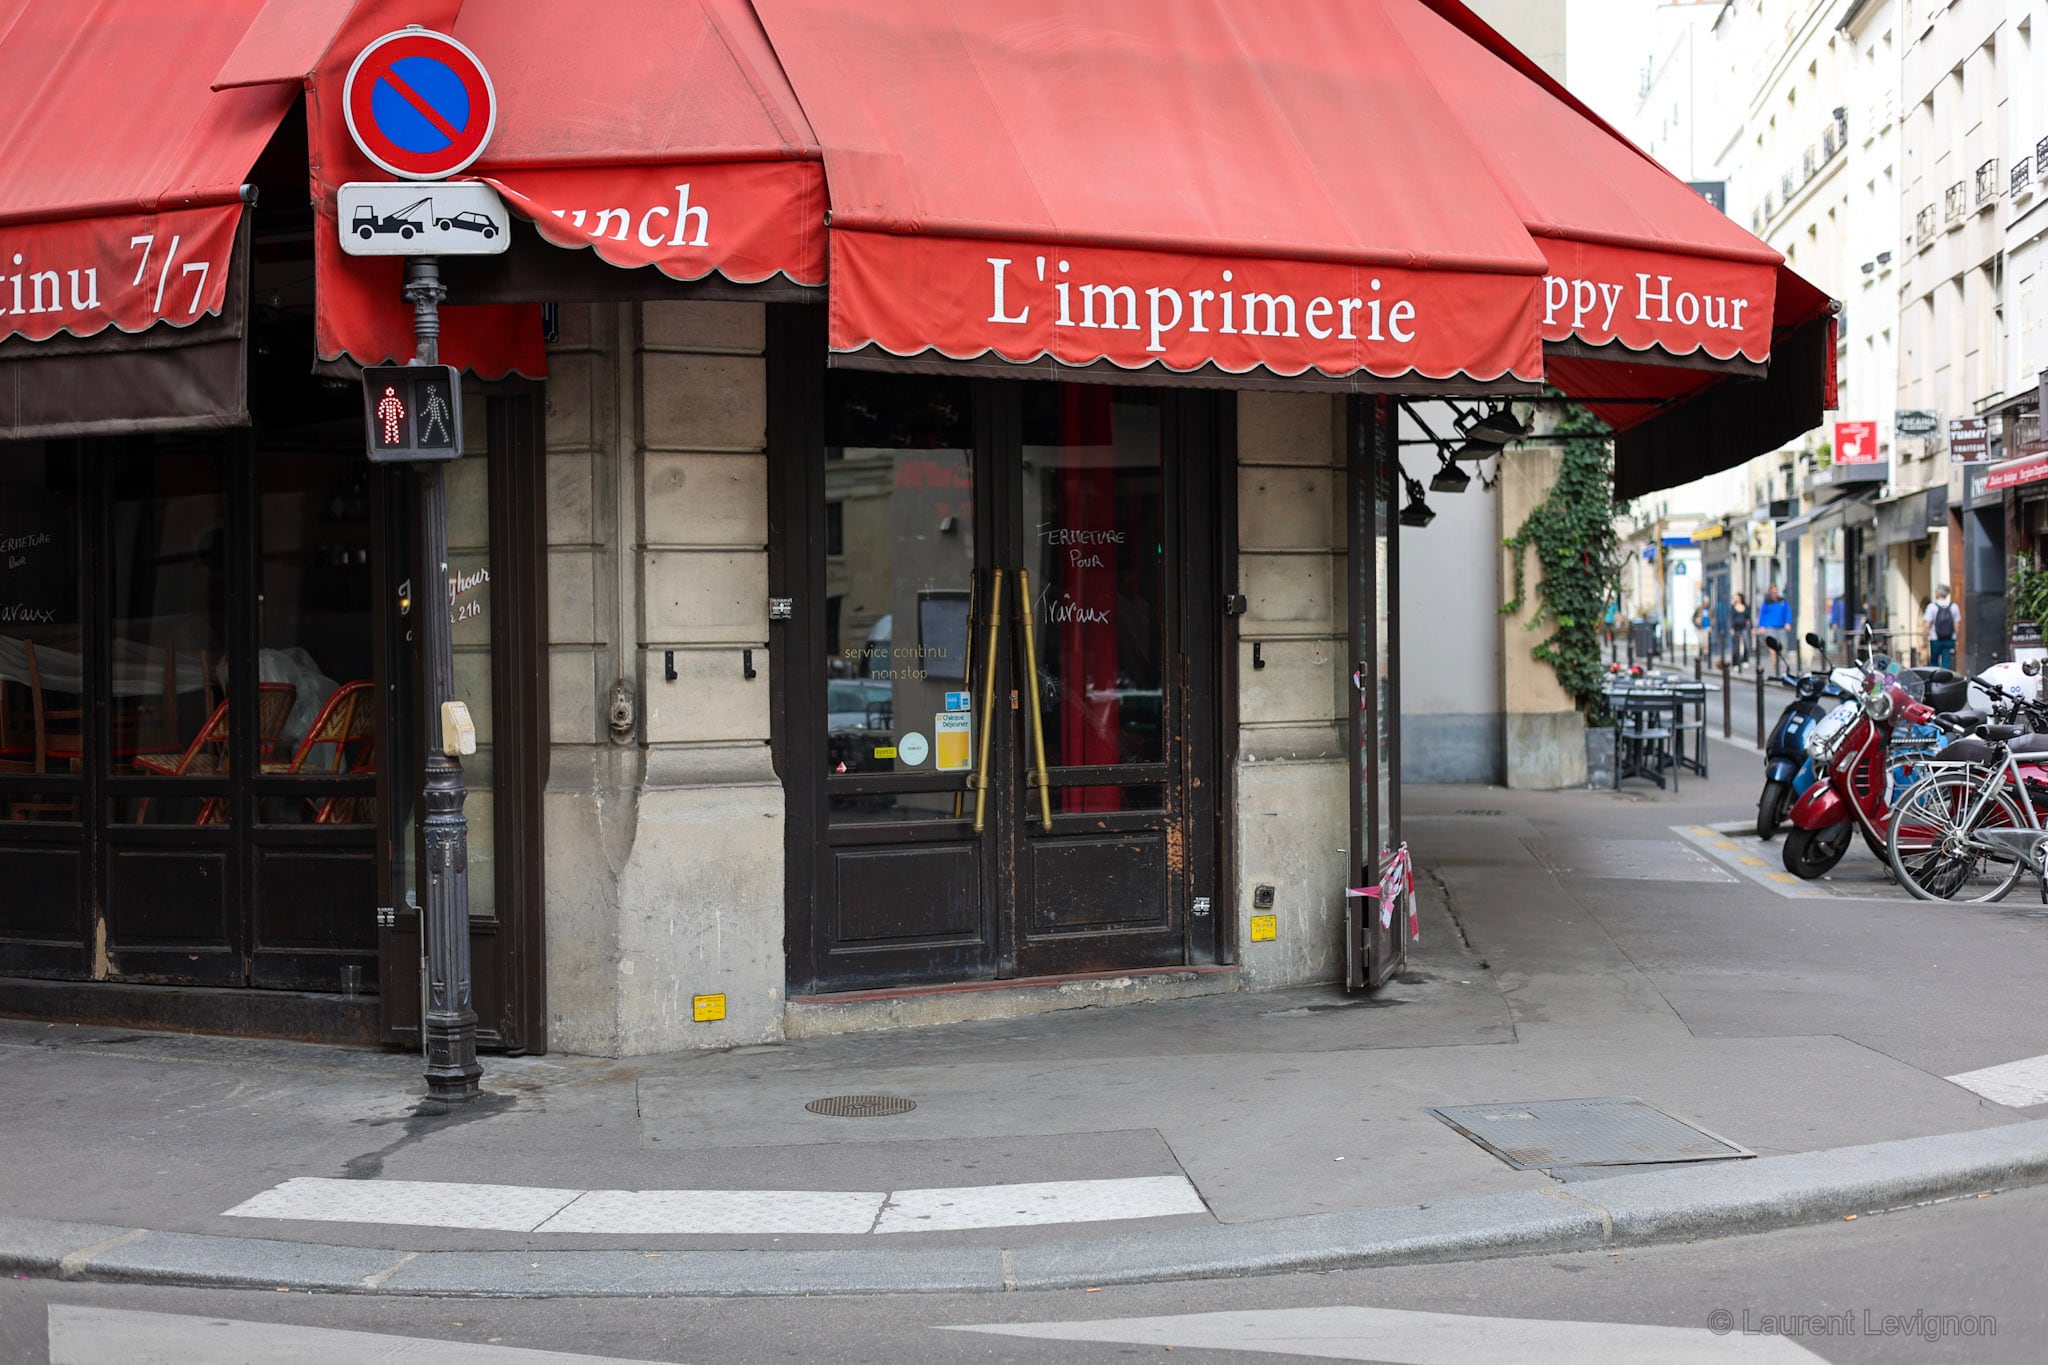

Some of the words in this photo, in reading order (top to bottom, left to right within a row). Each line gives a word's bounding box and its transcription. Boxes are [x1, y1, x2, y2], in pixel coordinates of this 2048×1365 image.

[130, 235, 210, 314] 7/7
[986, 256, 1416, 352] L'imprimerie
[1542, 275, 1623, 331] ppy
[1635, 273, 1748, 331] Hour
[1950, 429, 1987, 440] YUMMY
[0, 533, 51, 552] ERMETURE
[1034, 522, 1127, 548] FERMETURE
[1034, 582, 1111, 625] Travaux
[844, 644, 888, 659] service
[893, 643, 948, 659] continu
[872, 669, 898, 681] non
[900, 666, 929, 682] stop
